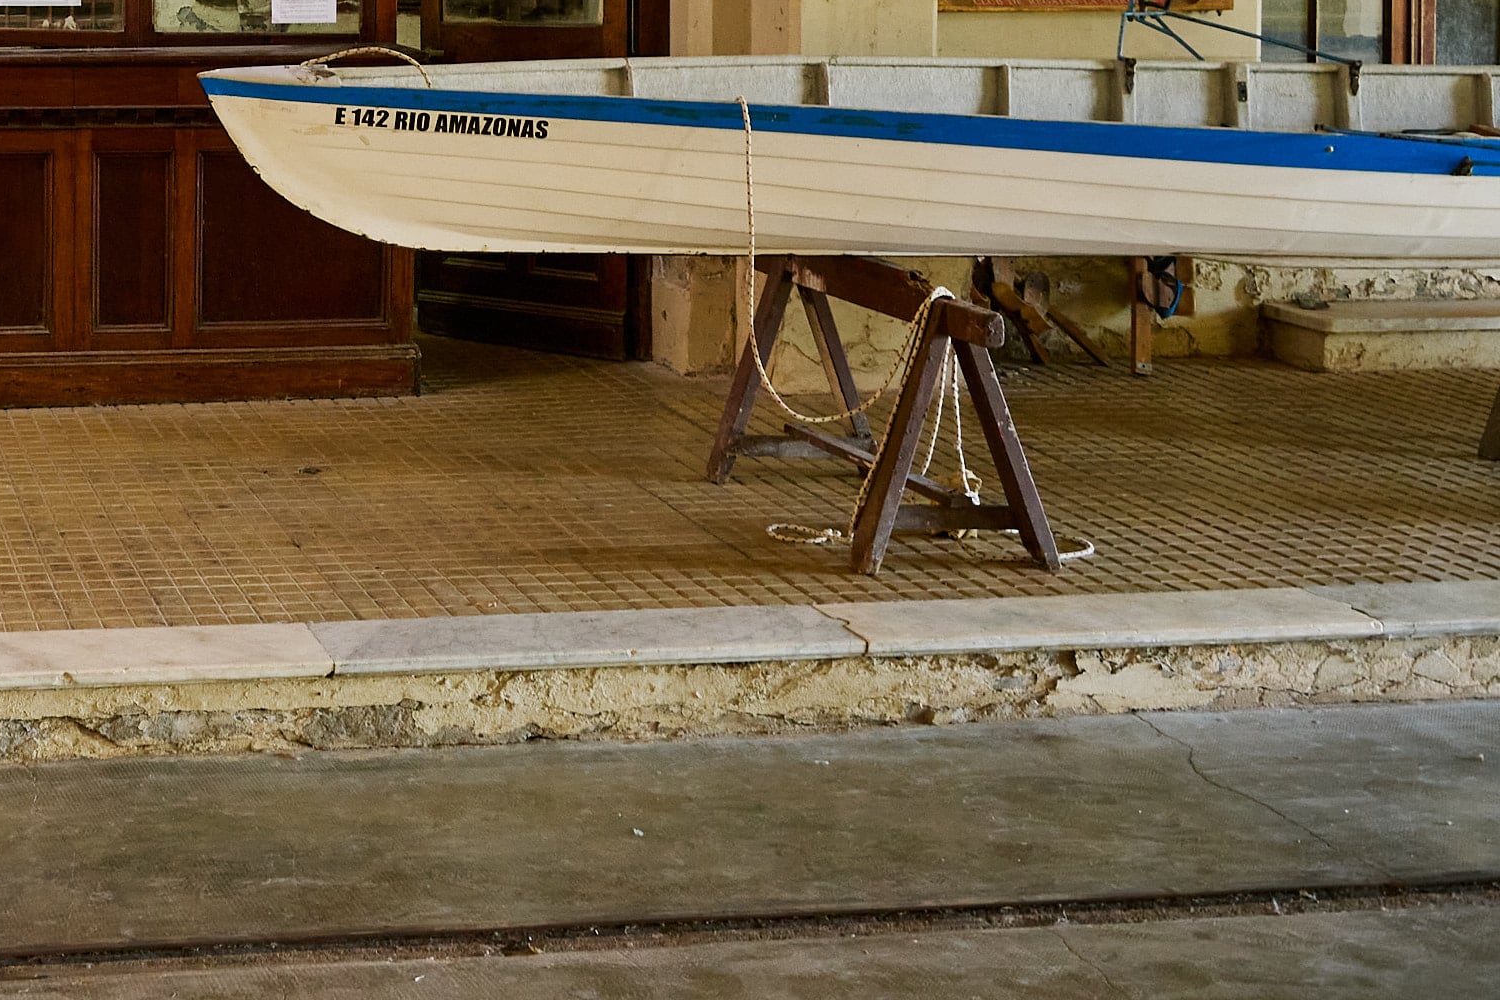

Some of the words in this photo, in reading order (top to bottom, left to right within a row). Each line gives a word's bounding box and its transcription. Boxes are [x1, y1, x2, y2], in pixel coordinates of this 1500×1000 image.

[334, 107, 347, 125] E
[351, 108, 390, 128] 142
[394, 110, 431, 132] RIO
[434, 113, 549, 139] AMAZONAS
